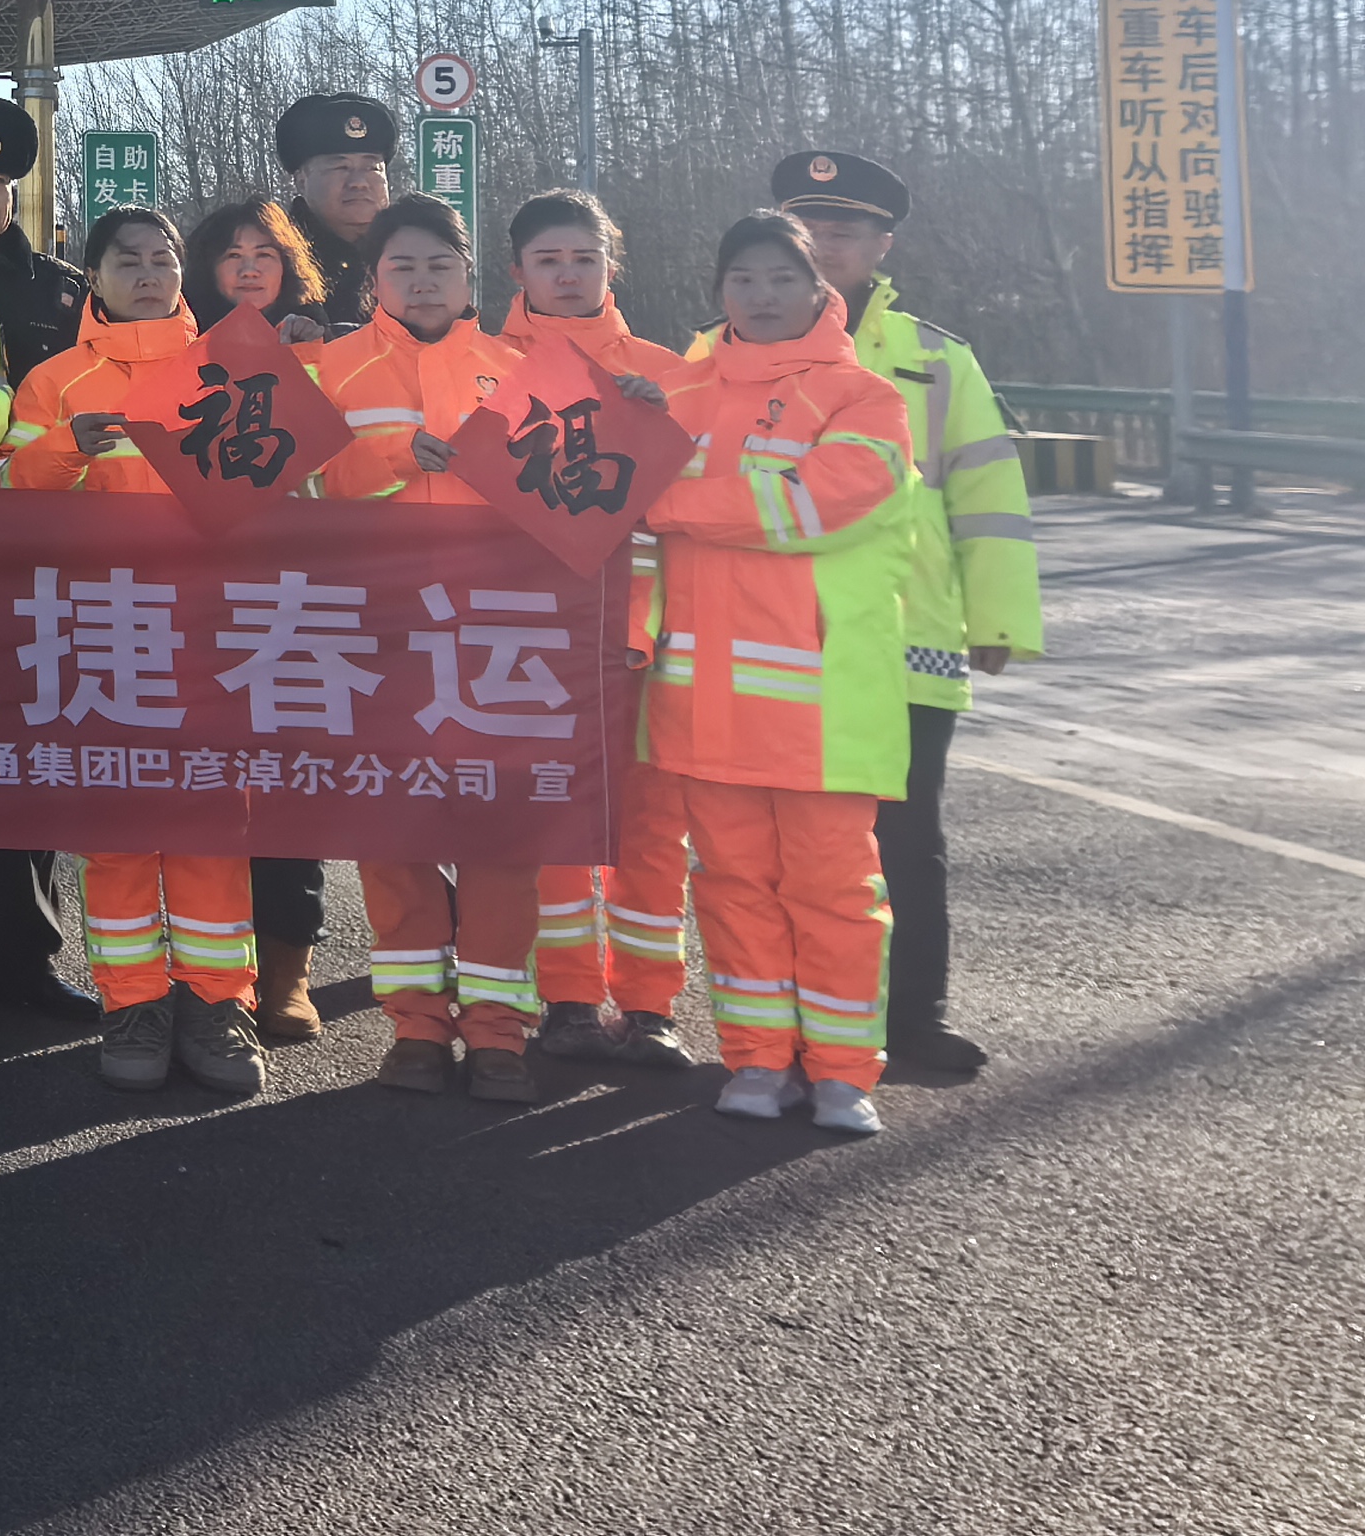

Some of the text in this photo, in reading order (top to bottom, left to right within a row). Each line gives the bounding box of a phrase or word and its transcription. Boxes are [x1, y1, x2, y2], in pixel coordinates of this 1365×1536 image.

[435, 67, 456, 95] 5
[95, 144, 147, 170] 自助
[431, 129, 465, 206] 称重
[94, 178, 148, 203] 发卡
[179, 362, 296, 488] 福
[507, 398, 635, 516] 福
[528, 760, 577, 803] 宣
